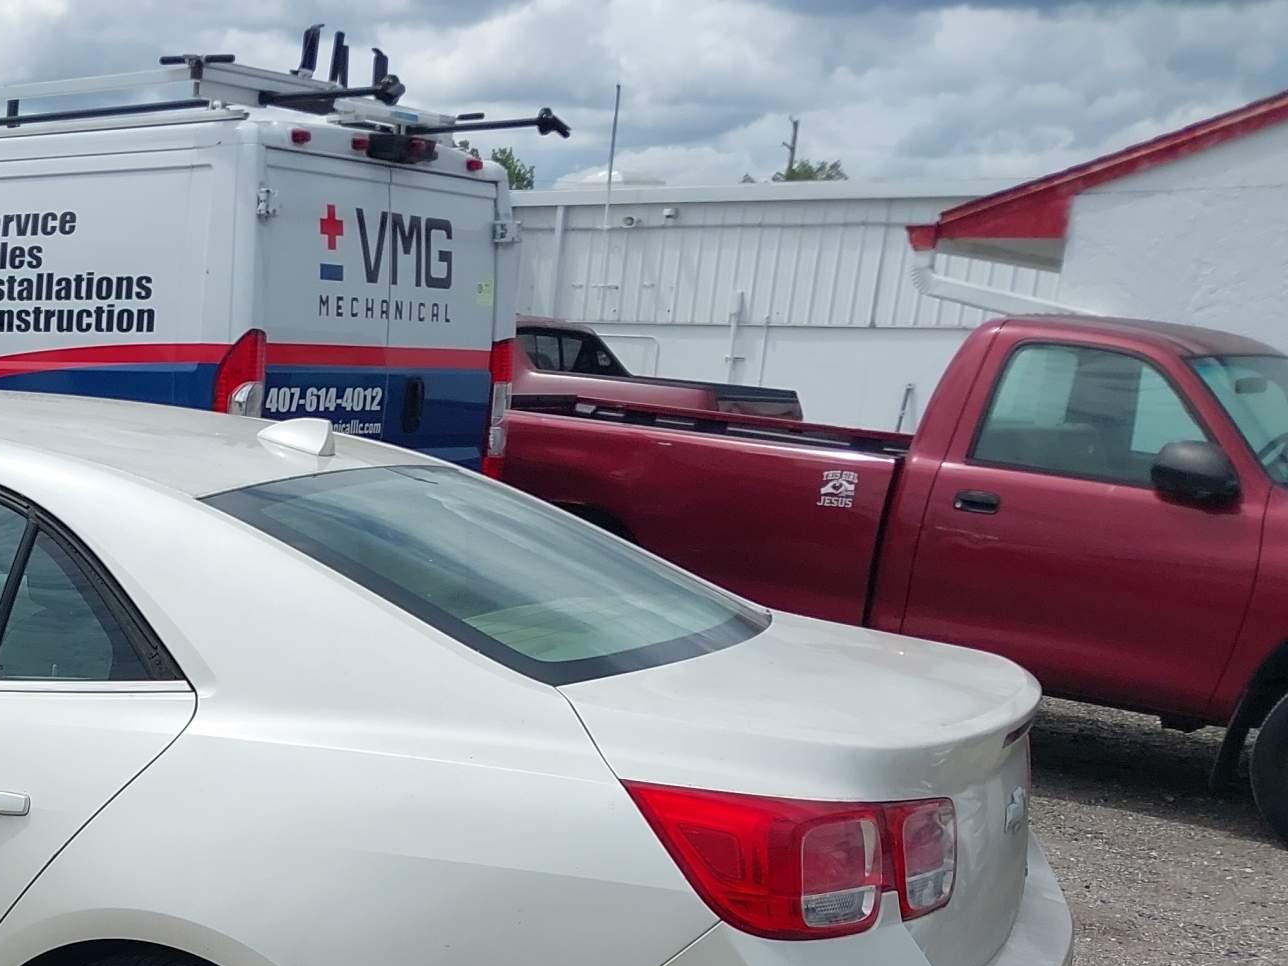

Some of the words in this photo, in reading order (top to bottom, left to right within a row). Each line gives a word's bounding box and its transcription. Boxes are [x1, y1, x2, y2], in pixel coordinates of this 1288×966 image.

[355, 207, 453, 290] VMG
[318, 295, 451, 323] MECHANICAL
[264, 386, 383, 412] 407-614-4012
[816, 495, 853, 508] JESUS
